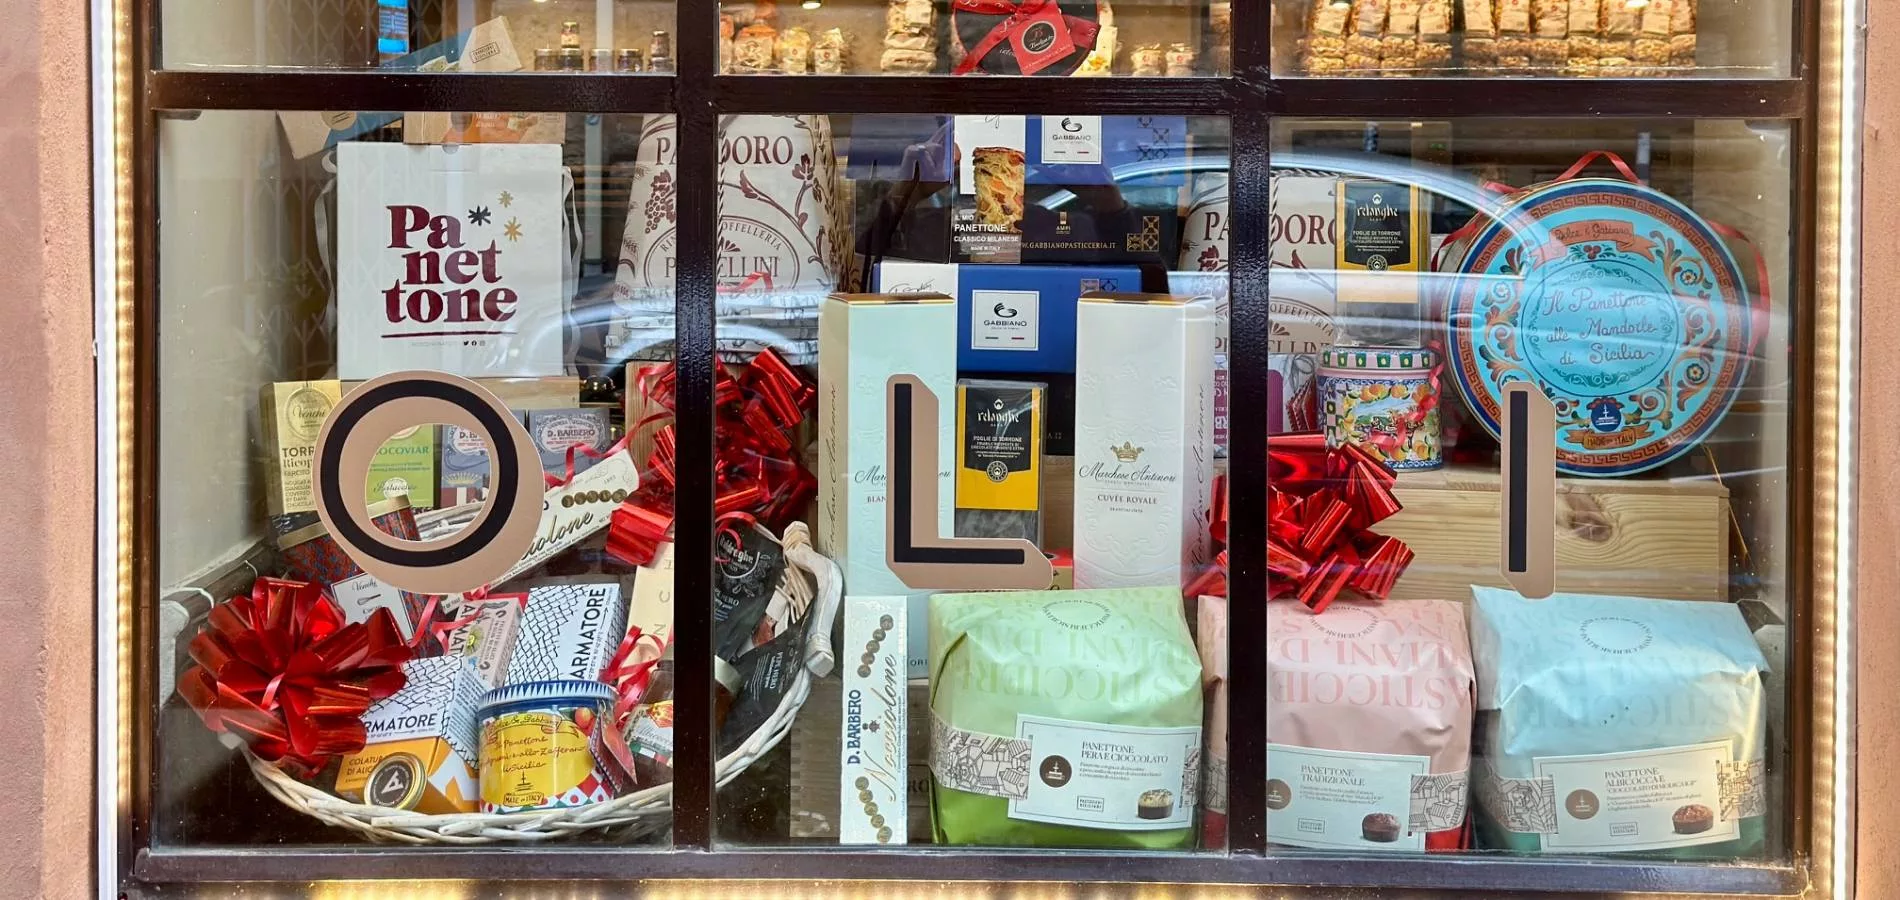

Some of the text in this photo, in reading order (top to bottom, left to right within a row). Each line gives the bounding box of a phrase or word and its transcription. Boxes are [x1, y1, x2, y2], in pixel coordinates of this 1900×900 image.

[386, 205, 466, 249] Pa
[954, 224, 1007, 232] PANETTONE
[402, 239, 502, 284] net
[381, 279, 518, 323] tone
[1543, 287, 1649, 315] Il Panettone
[1547, 319, 1657, 342] alle Mandorle
[1560, 343, 1655, 365] di Sicilia
[292, 406, 326, 419] Venchi
[557, 429, 595, 437] BARBERO
[282, 446, 314, 459] TORR
[378, 446, 429, 455] OCOVIAR
[283, 459, 312, 470] Ricop
[1079, 462, 1176, 483] Marchese Antinori
[1097, 494, 1157, 504] CUVÉE ROYALE
[569, 587, 606, 679] ARMATORE
[365, 713, 438, 733] RMATORE
[847, 689, 861, 765] D. BARBERO
[863, 654, 897, 802] Nocciolone
[1082, 741, 1135, 754] PANETTONE
[348, 755, 383, 766] COLATU
[1081, 751, 1169, 763] PERA E CIOCCOLATO
[356, 765, 372, 774] ALIC
[1301, 765, 1354, 777] PANETTONE
[1604, 767, 1660, 779] PANETTONE
[1302, 774, 1366, 786] TRADIZIONALE
[1607, 776, 1656, 787] ALBICOCCA
